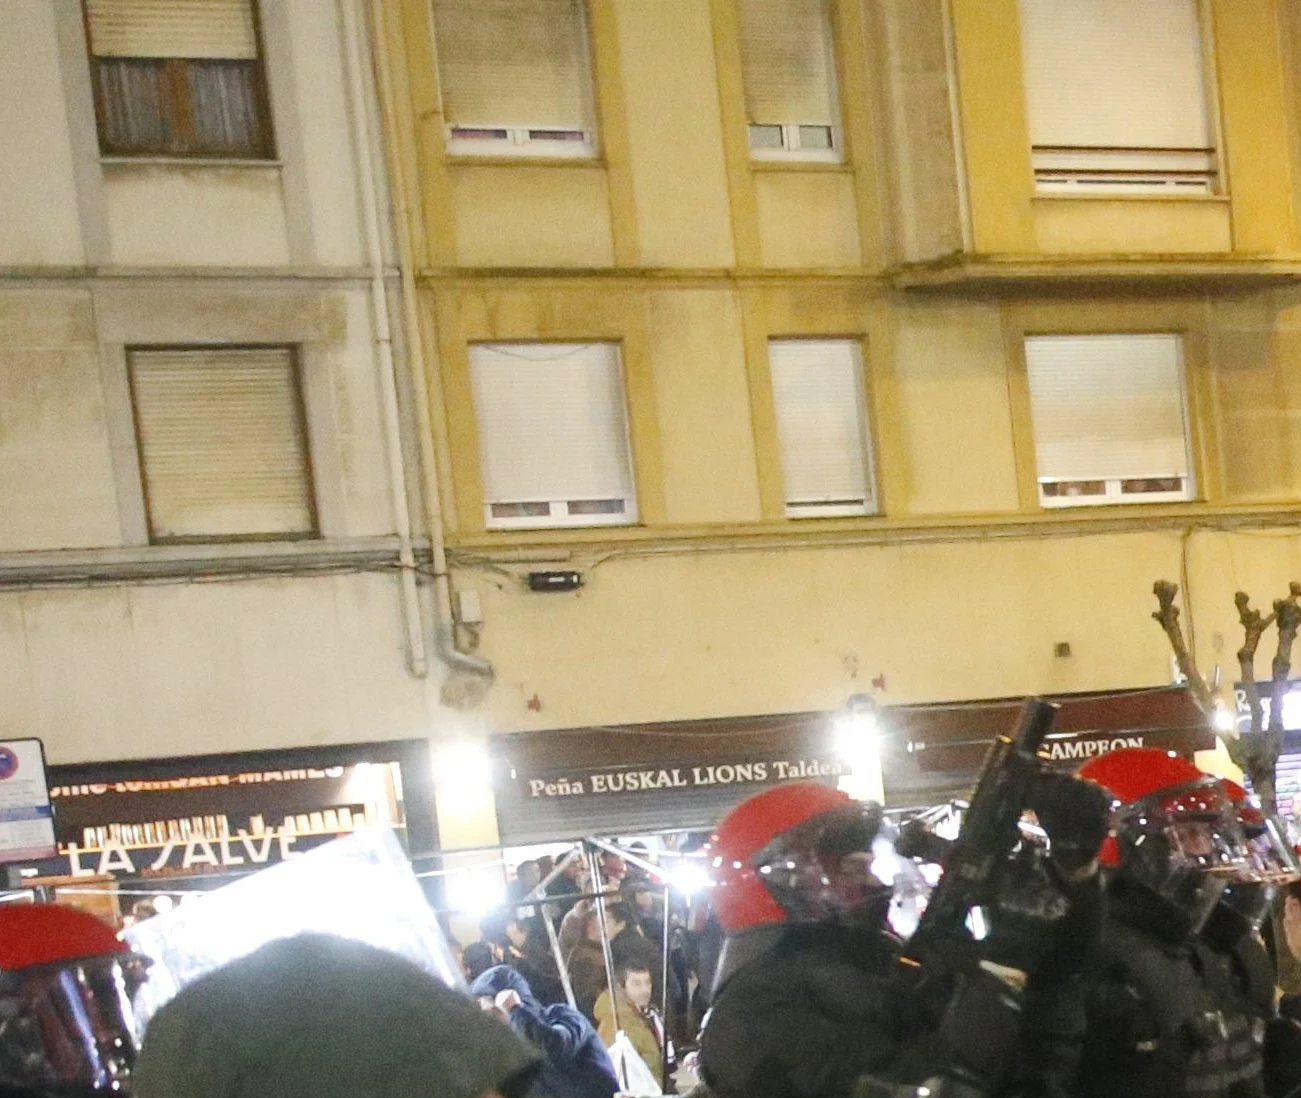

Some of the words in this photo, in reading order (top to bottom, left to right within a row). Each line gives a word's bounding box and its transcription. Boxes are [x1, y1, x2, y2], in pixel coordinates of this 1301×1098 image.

[530, 779, 584, 797] Peña
[591, 769, 687, 793] EUSKAL
[694, 763, 767, 786] LIONS
[773, 760, 842, 782] Taldea
[68, 839, 136, 878] LA
